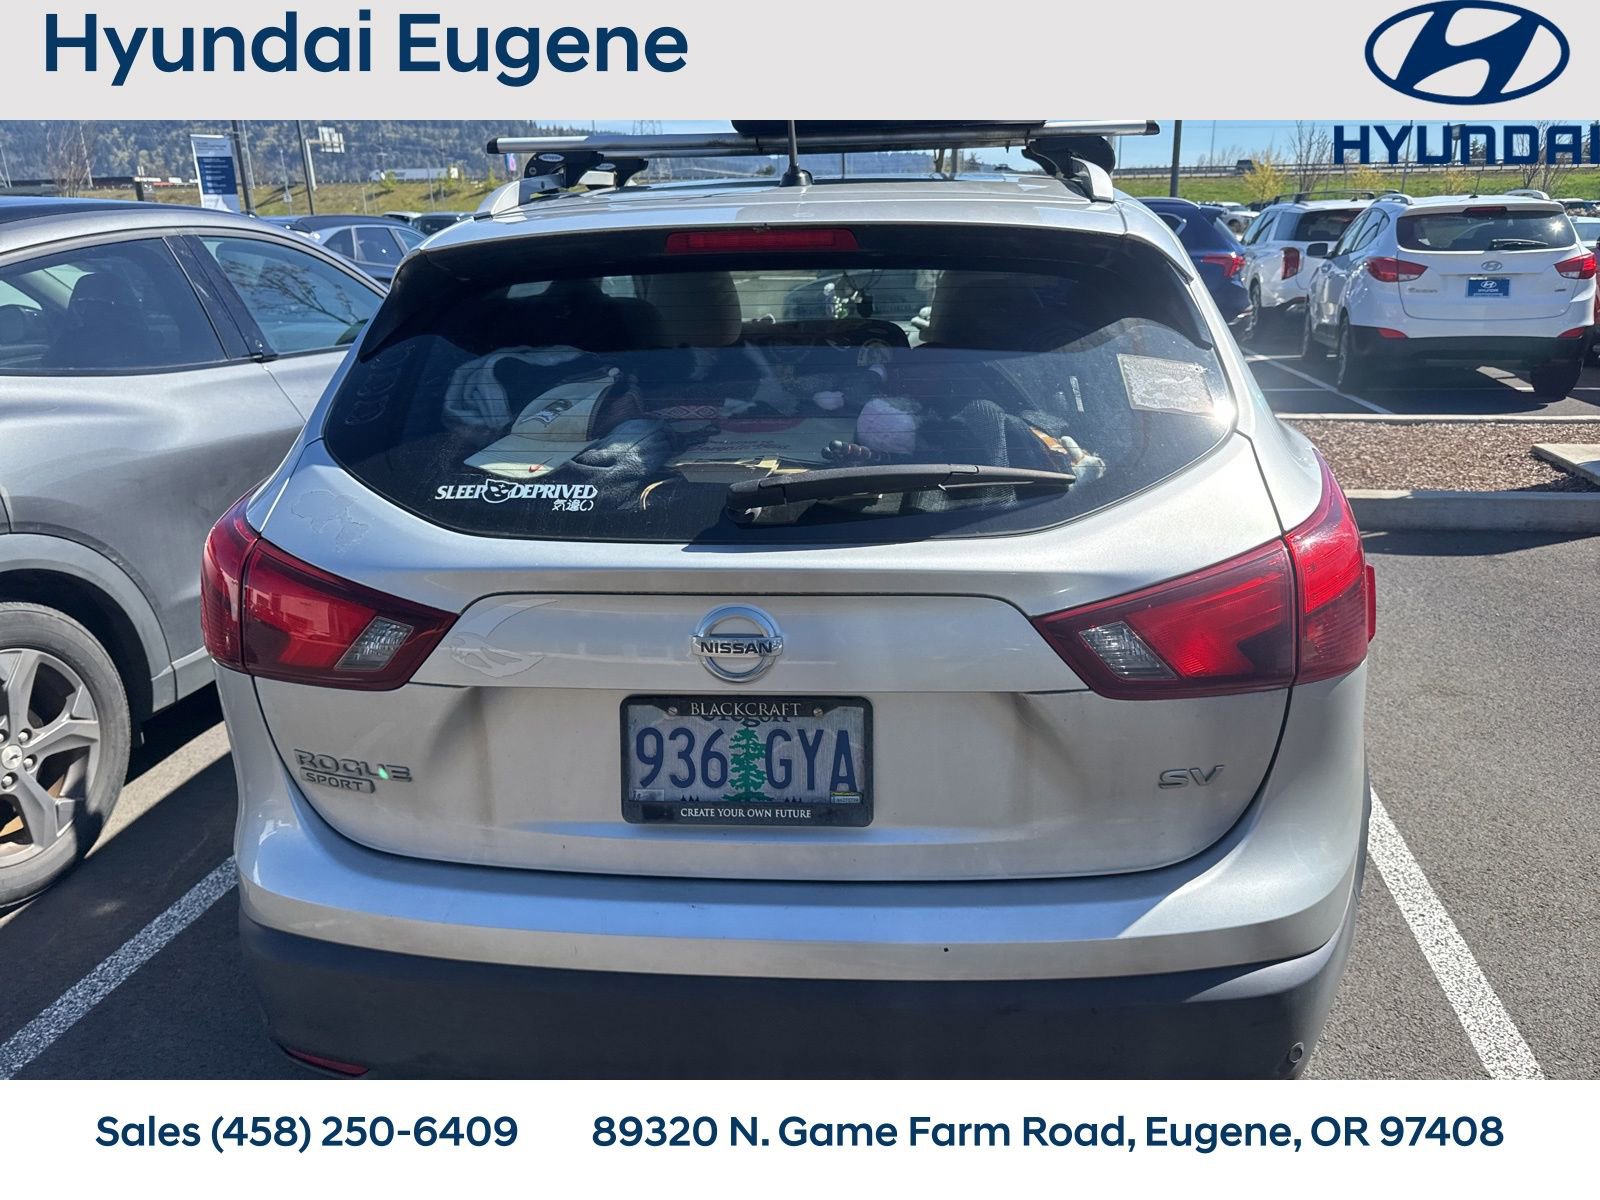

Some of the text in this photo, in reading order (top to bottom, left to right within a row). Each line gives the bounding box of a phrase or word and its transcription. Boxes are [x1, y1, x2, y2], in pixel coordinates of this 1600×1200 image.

[509, 484, 598, 499] DEPRIVED
[700, 641, 773, 654] NISSAN
[690, 702, 802, 716] BLACKCRAFT
[293, 748, 413, 783] ROGUE
[635, 726, 857, 792] 936 GYA
[305, 772, 363, 792] SPORT
[1158, 764, 1225, 790] SV
[680, 808, 812, 818] CREATE YOUR OWN FUTURE
